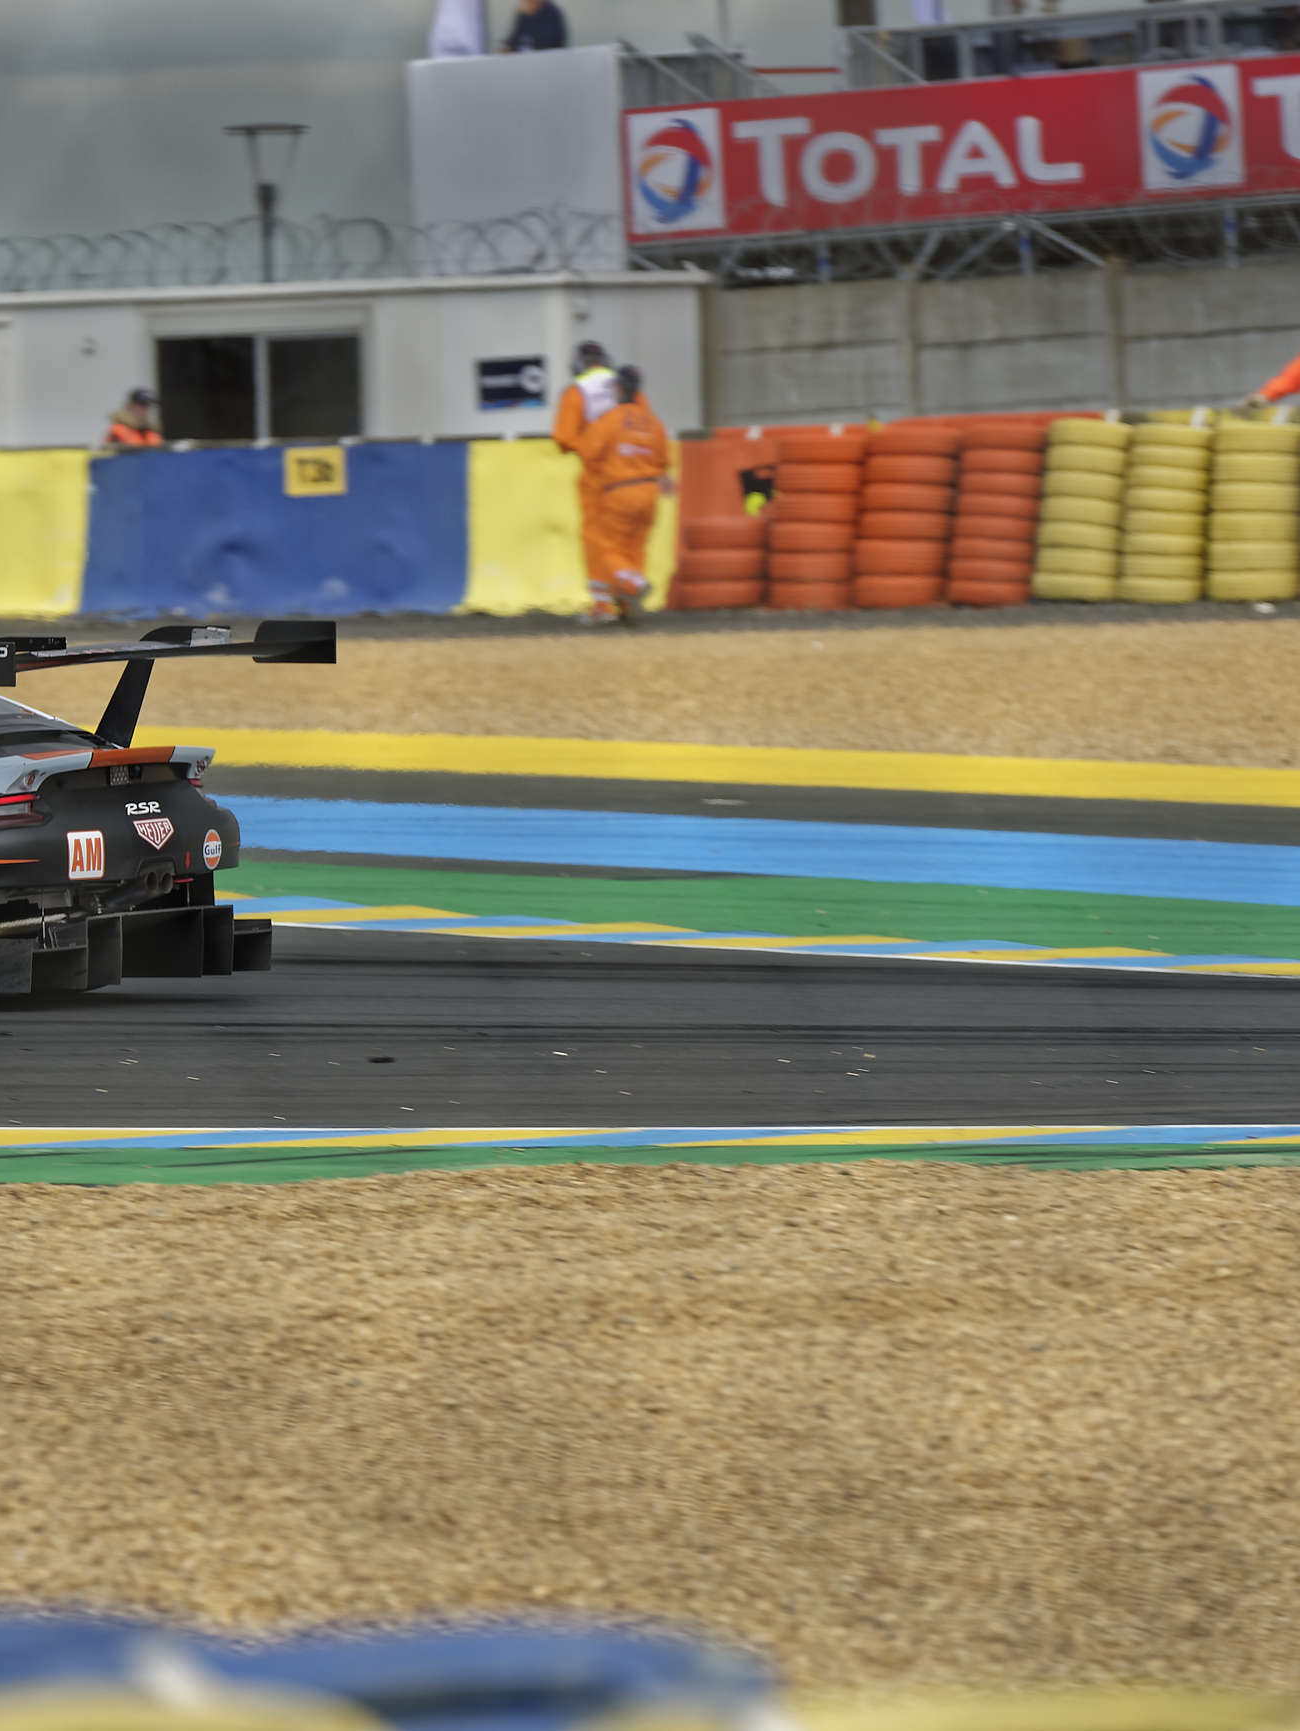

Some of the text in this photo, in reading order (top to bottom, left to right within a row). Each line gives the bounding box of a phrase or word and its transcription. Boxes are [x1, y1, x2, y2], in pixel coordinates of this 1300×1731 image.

[732, 115, 1084, 208] TOTAL
[125, 801, 161, 815] RSR
[138, 822, 172, 844] HEUER
[71, 837, 102, 873] AM
[204, 845, 221, 856] Gulf
